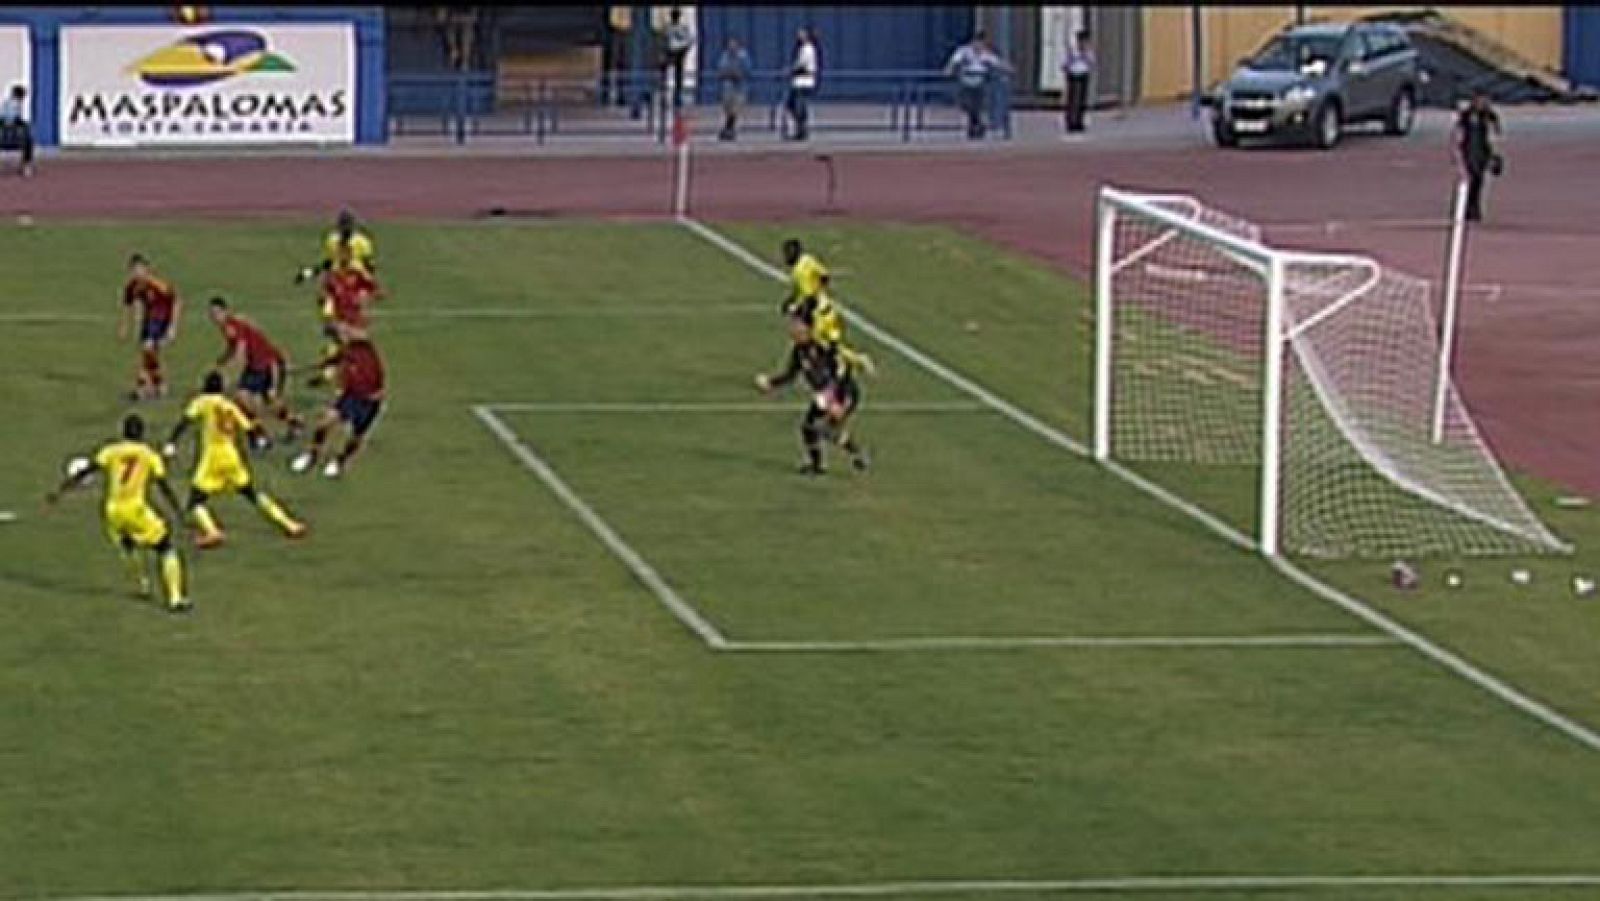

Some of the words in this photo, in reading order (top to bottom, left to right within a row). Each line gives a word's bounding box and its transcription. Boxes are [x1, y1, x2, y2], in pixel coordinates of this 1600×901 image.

[69, 91, 346, 123] MASPALOMAS
[101, 121, 182, 134] COSTA
[119, 454, 139, 485] 7
